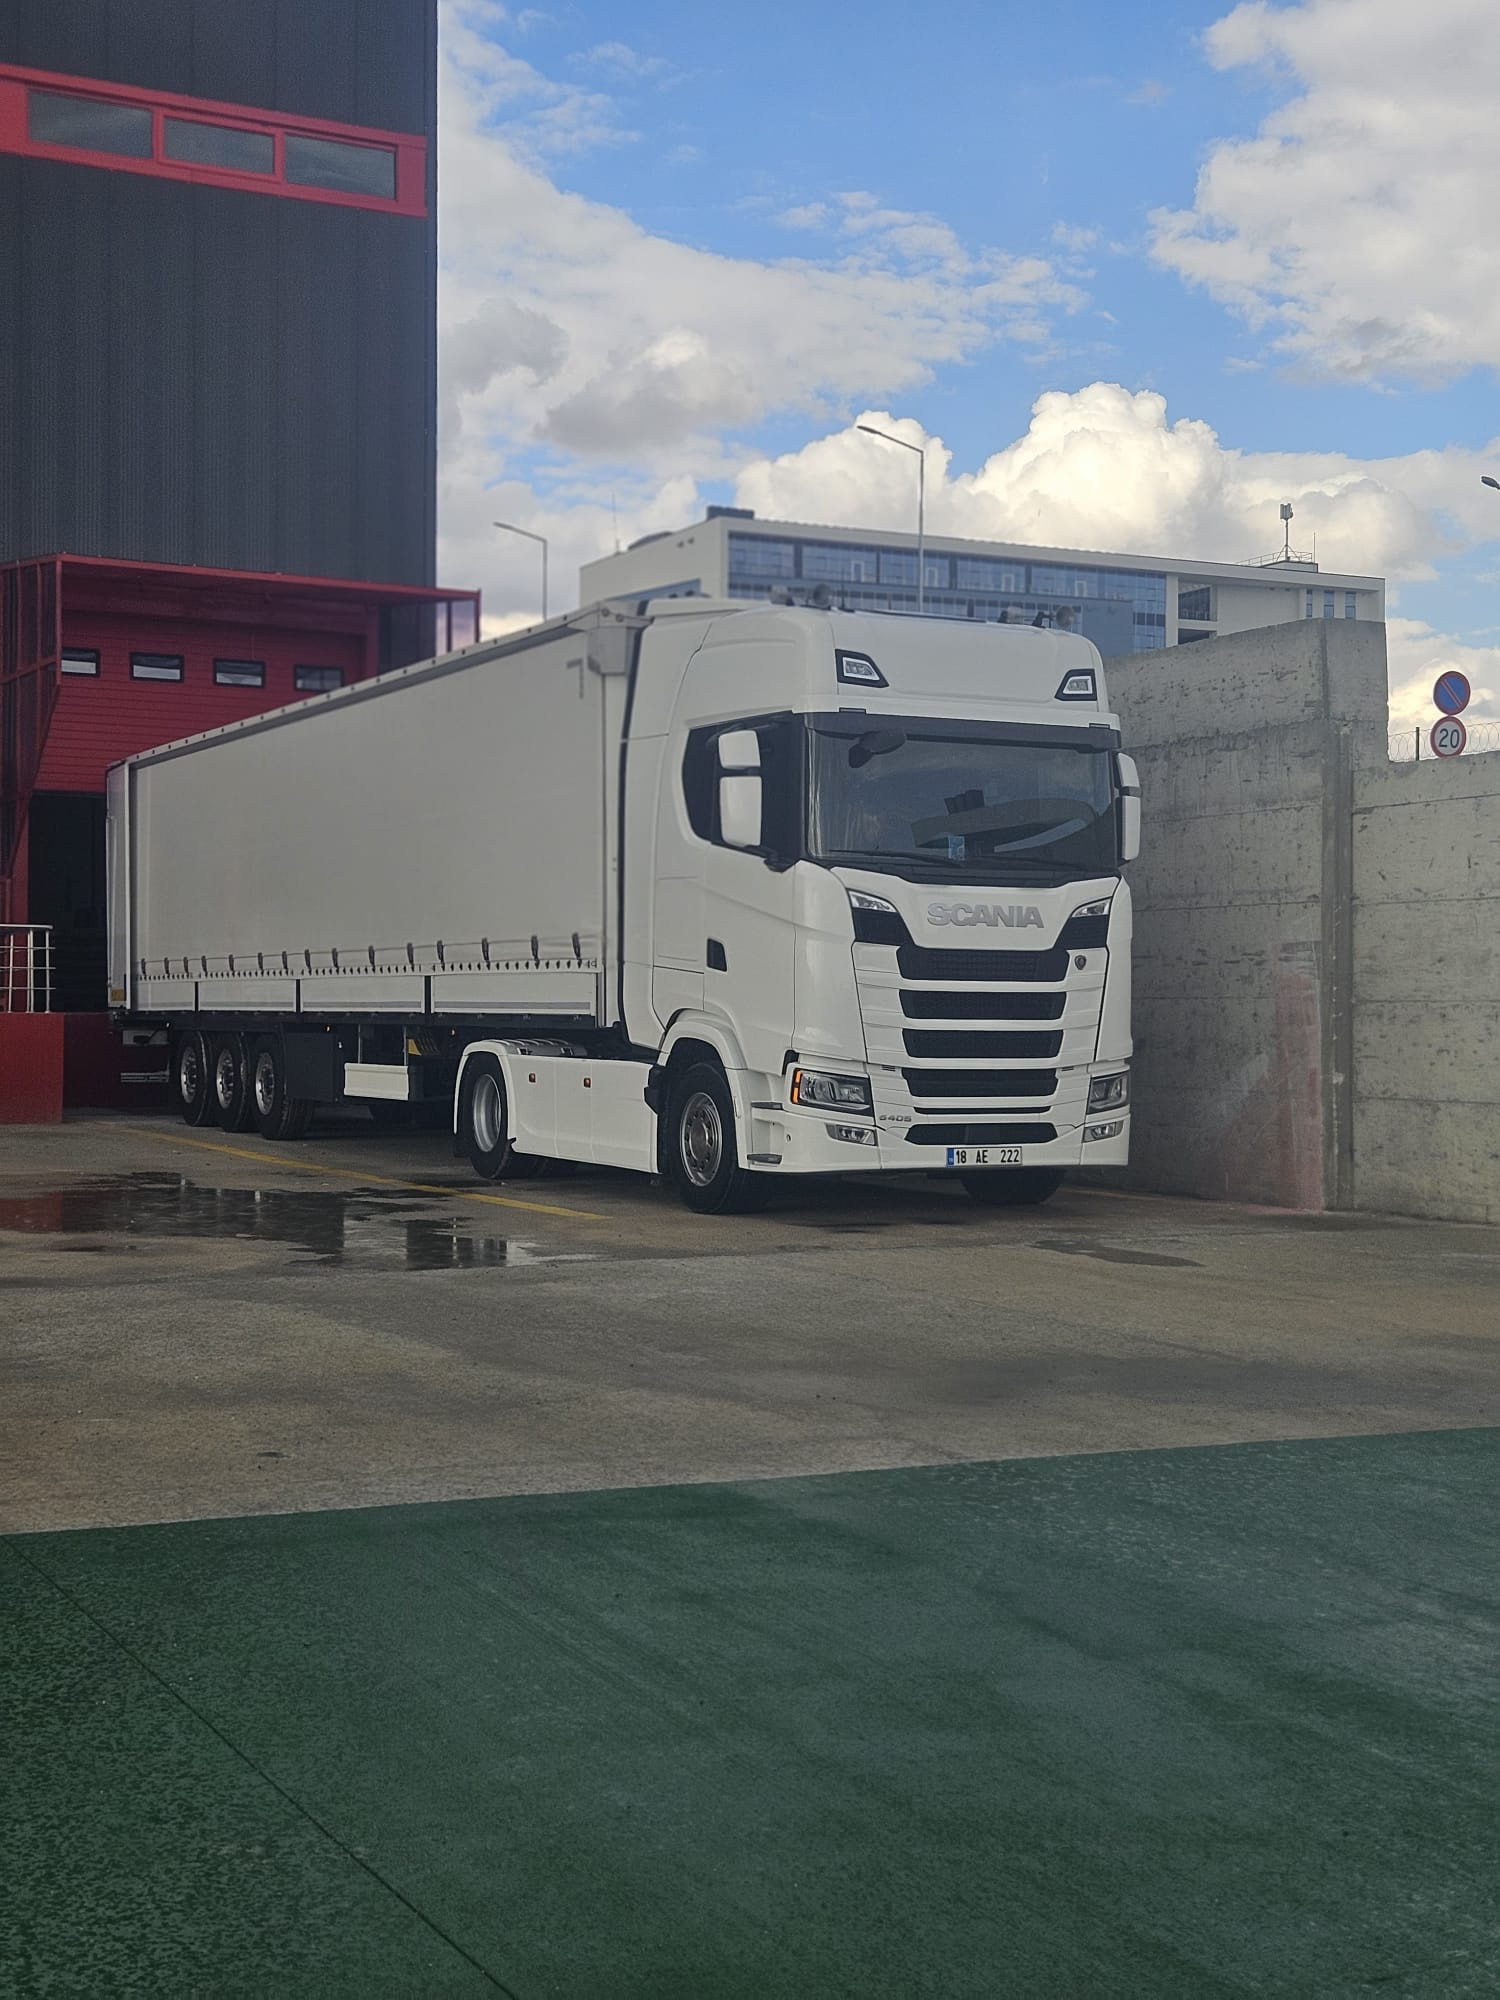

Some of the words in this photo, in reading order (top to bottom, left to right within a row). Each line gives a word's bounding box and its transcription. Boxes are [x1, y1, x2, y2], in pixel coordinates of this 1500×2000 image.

[1439, 728, 1460, 748] 20
[927, 902, 1044, 928] SCANIA
[956, 1150, 967, 1164] 18
[976, 1150, 988, 1163] AE
[1000, 1149, 1020, 1163] 222
